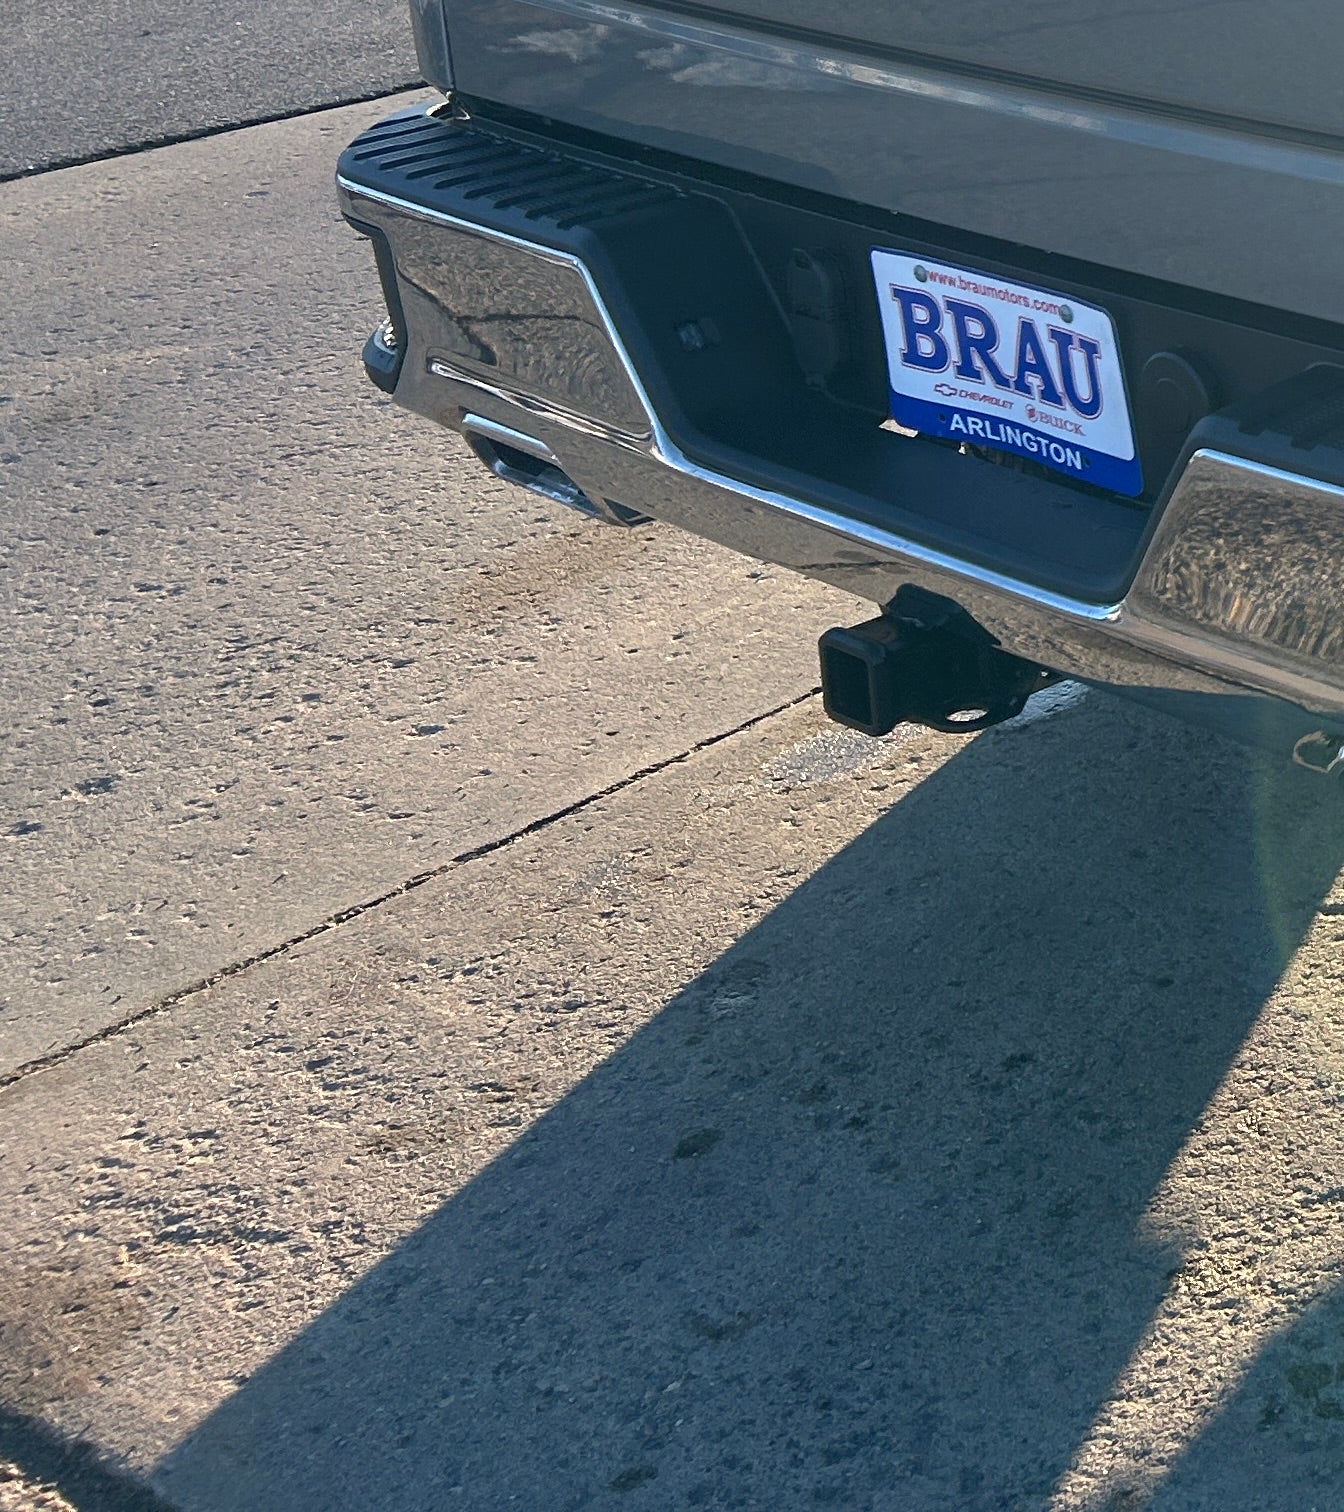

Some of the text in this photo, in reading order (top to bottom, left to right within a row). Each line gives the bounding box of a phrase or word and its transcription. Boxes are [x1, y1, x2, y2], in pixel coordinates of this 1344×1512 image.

[926, 269, 1062, 315] www.braumotors.com
[889, 283, 1105, 420] BRAU
[958, 389, 1087, 437] CHEVROLET BUICK
[949, 414, 1083, 470] ARLINGTON
